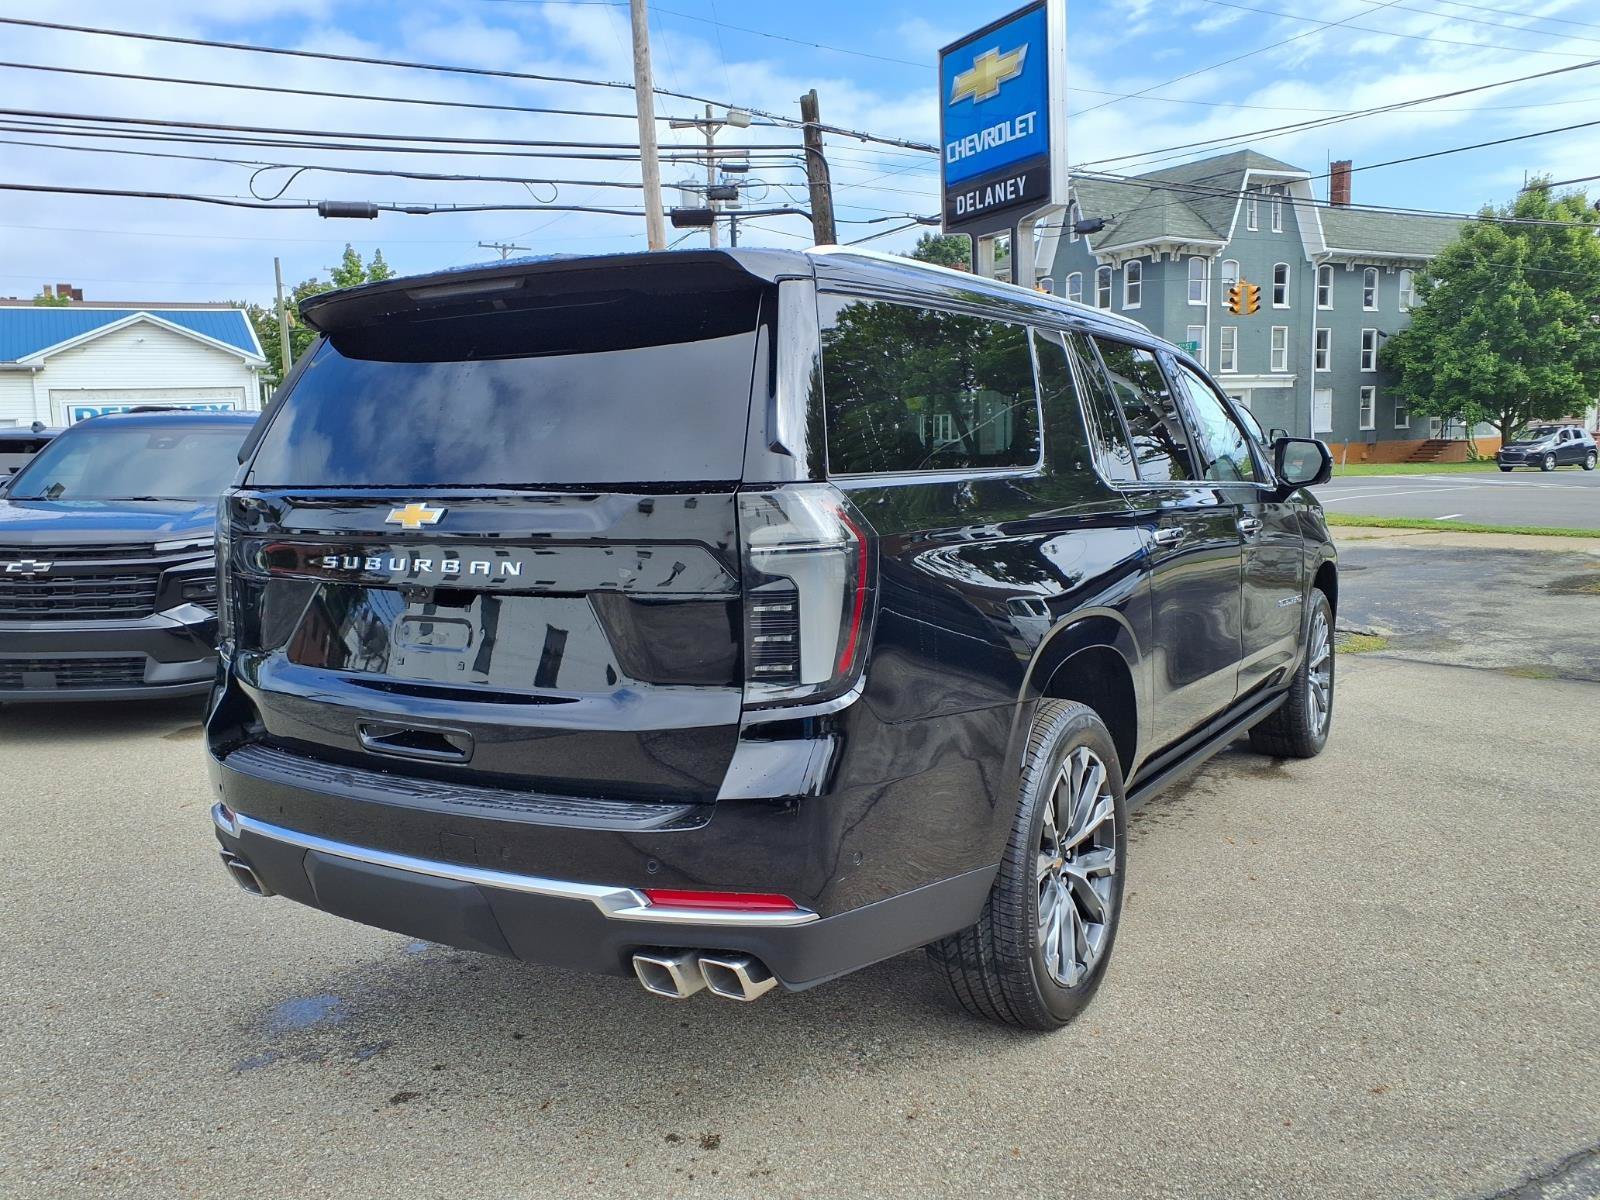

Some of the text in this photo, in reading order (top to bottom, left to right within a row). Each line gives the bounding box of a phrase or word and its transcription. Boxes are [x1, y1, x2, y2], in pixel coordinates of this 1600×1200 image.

[946, 111, 1037, 163] CHEVROLET
[956, 175, 1027, 215] DELANEY
[322, 556, 523, 576] SUBURBAN
